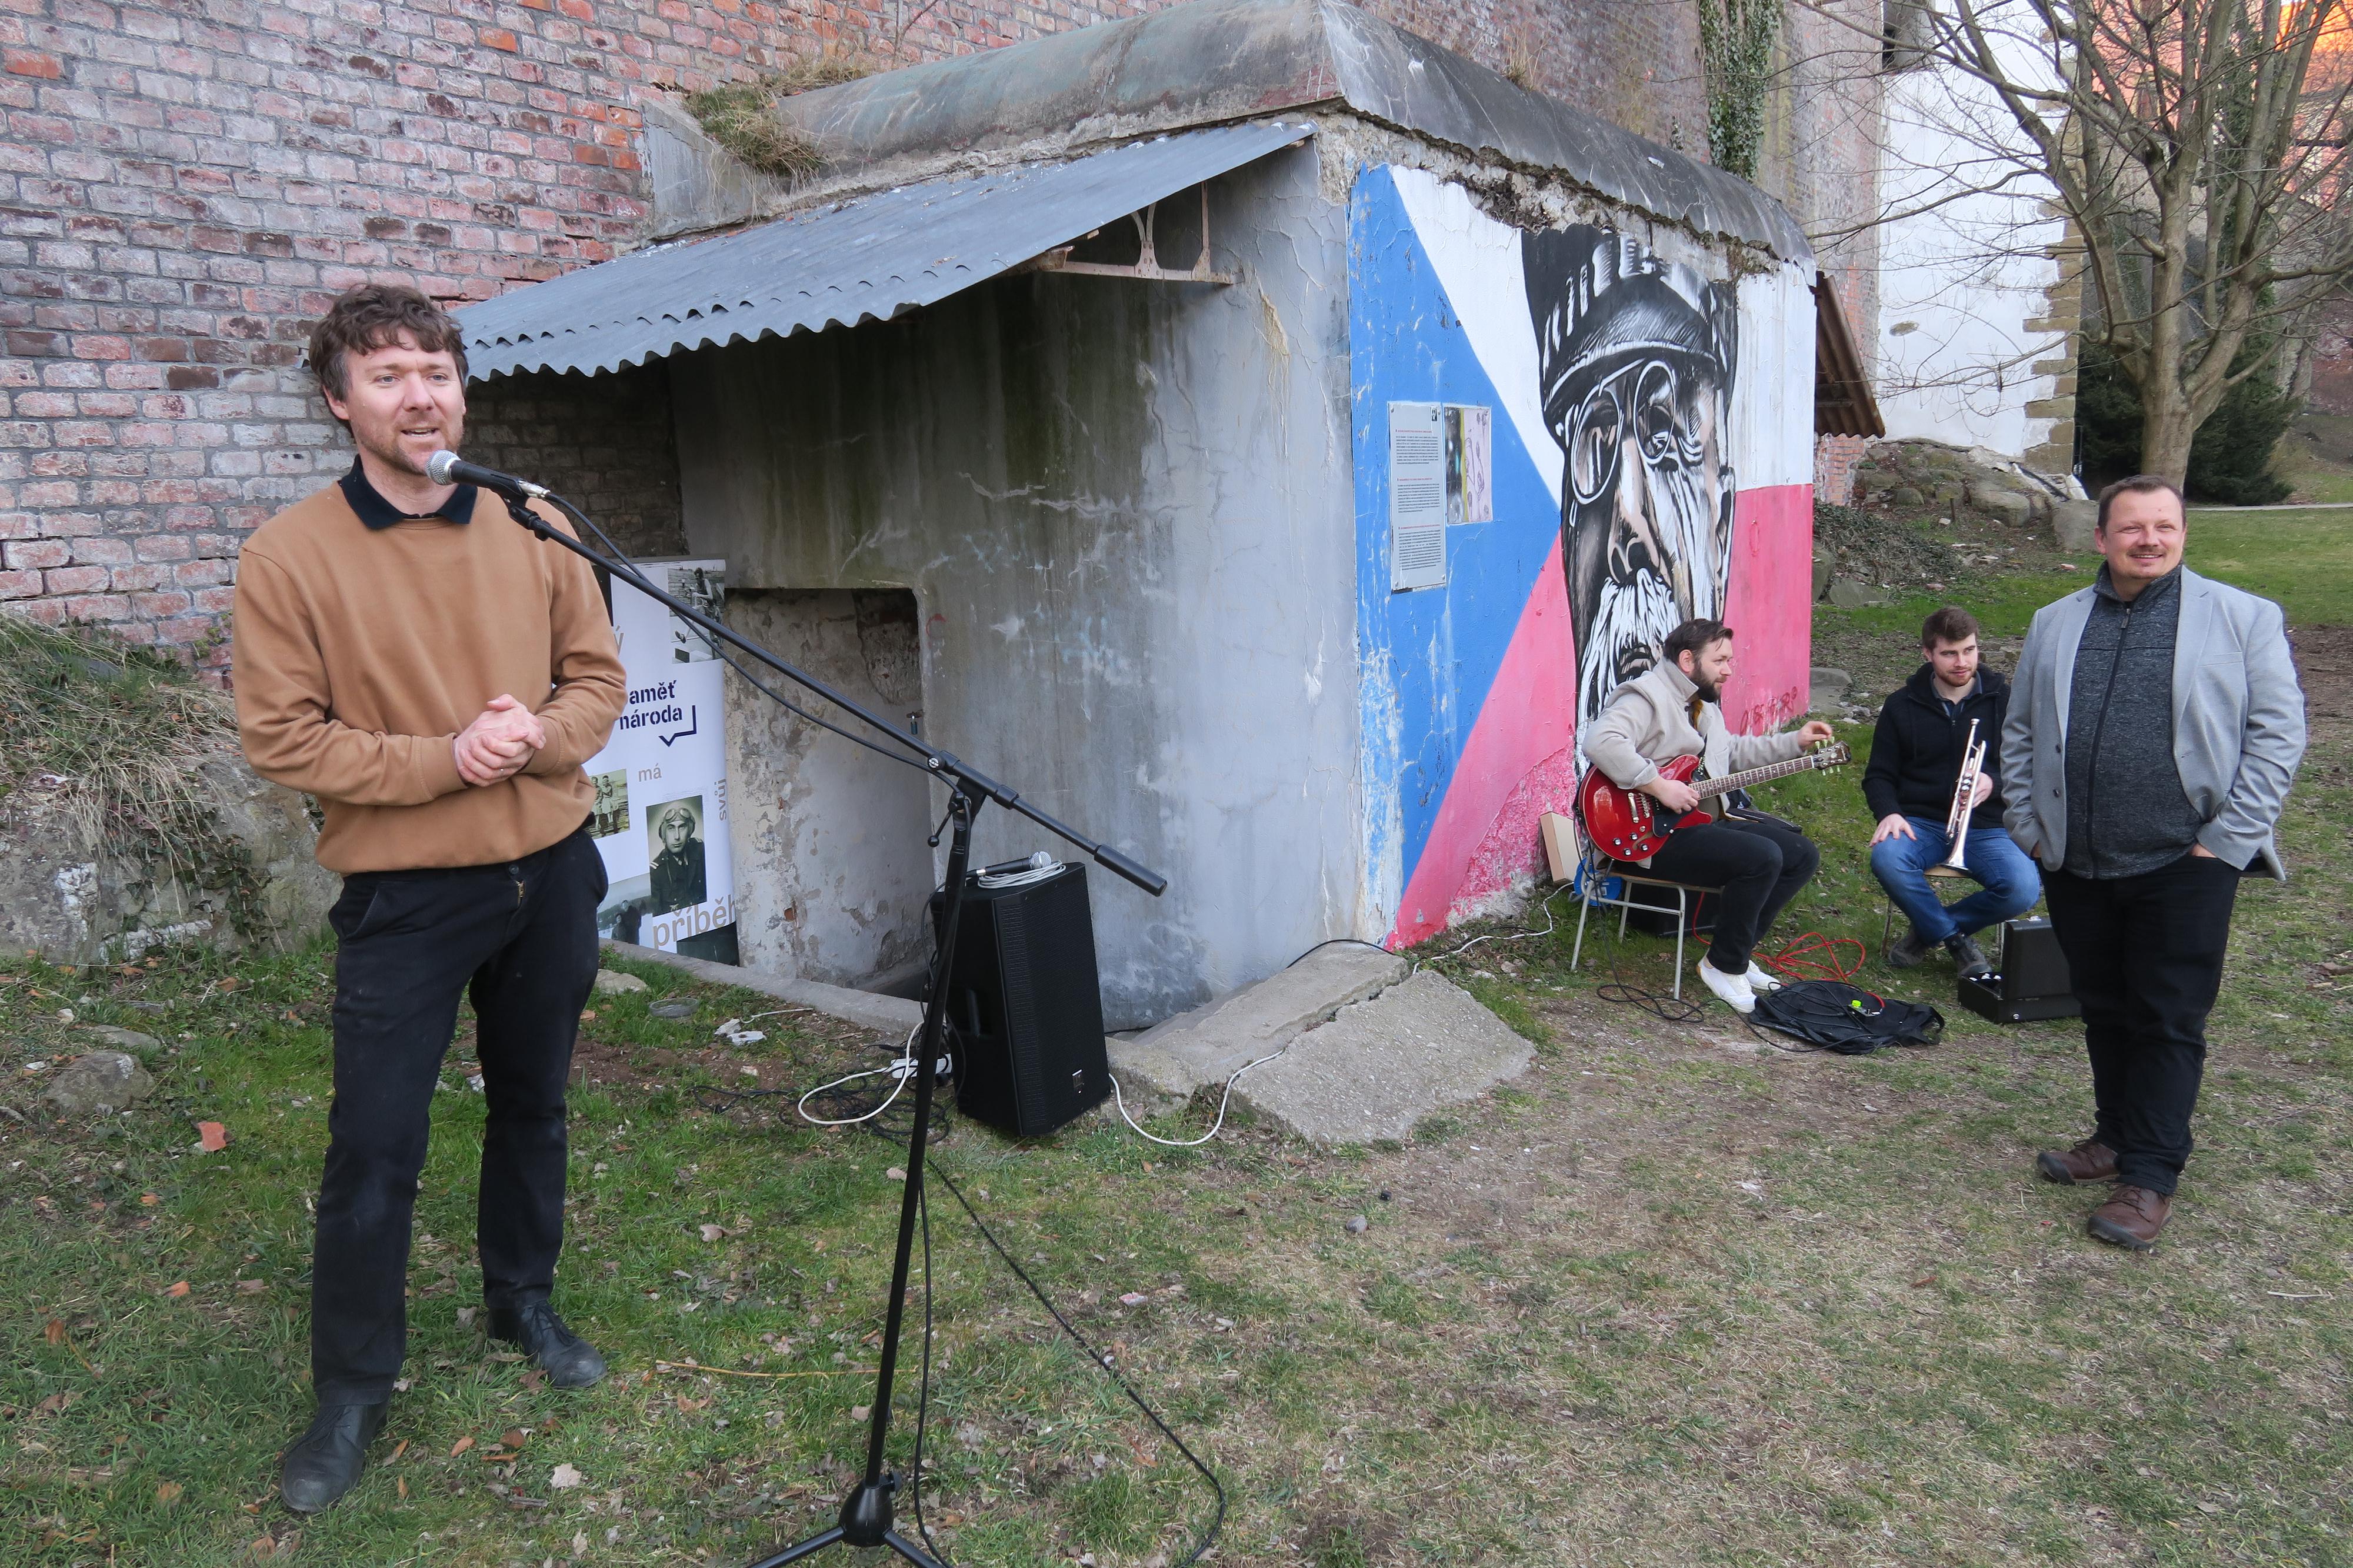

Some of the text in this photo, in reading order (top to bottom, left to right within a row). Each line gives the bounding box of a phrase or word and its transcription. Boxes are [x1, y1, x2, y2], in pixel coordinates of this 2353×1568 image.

[629, 680, 676, 704] aměť
[619, 705, 682, 730] národa
[638, 763, 662, 782] má
[714, 778, 727, 821] svůj
